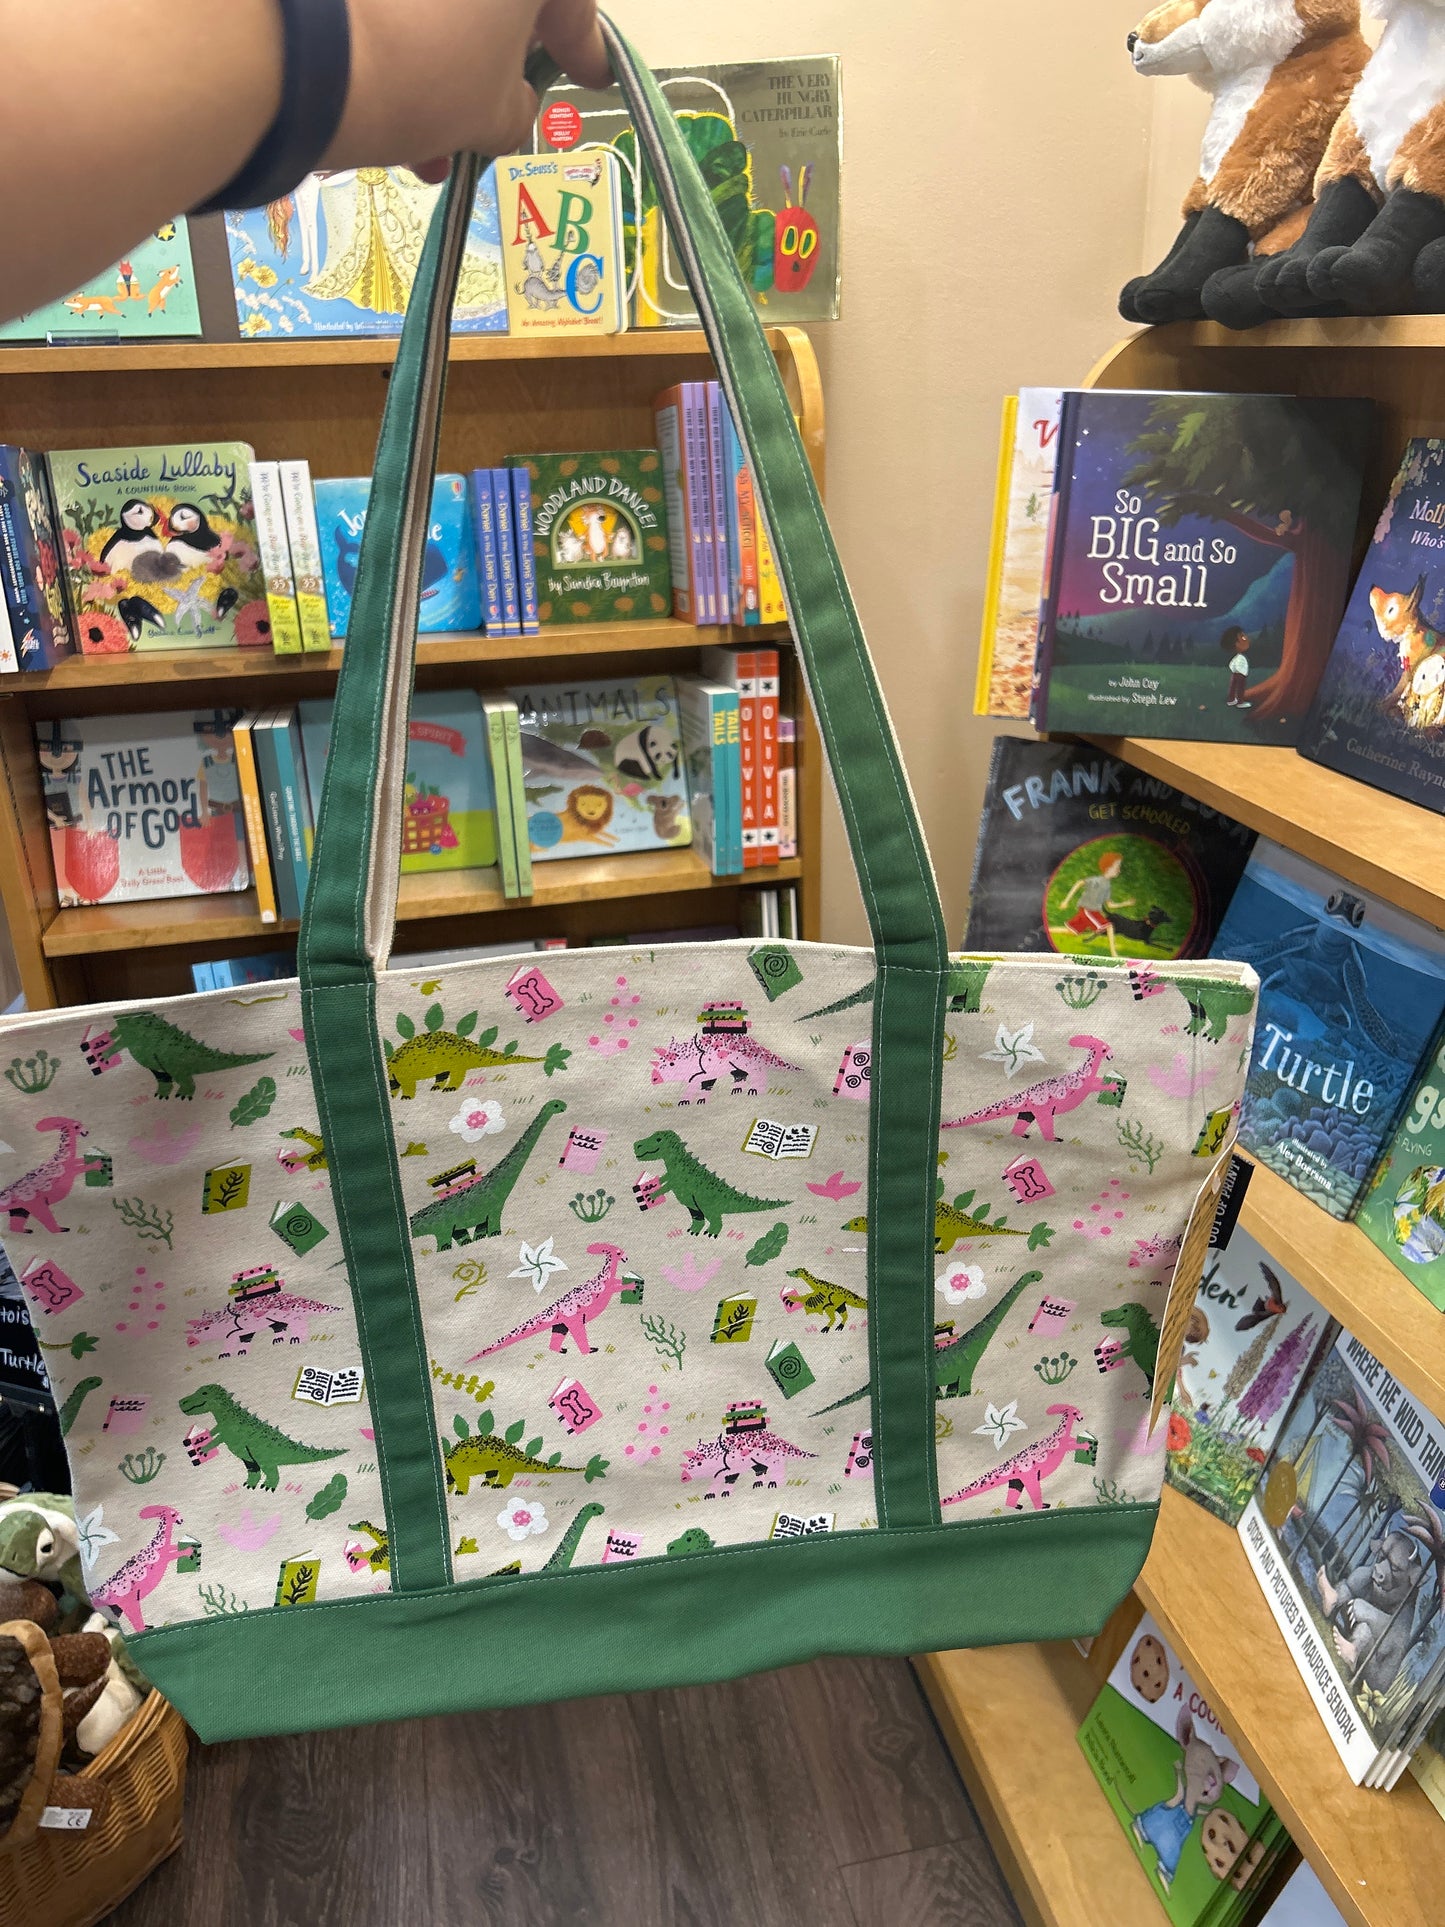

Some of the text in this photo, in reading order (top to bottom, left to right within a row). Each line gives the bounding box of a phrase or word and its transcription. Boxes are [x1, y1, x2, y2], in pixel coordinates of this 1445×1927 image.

[767, 73, 830, 90] THE VERY
[777, 89, 831, 105] HUNGRY
[741, 105, 833, 123] CATERPILLAR
[508, 167, 525, 181] Dr.
[525, 161, 558, 177] Seuss's
[75, 451, 237, 501] Seaside Lullaby
[126, 485, 170, 495] COUNTING
[173, 484, 197, 493] BOOK
[532, 477, 659, 536] WOODLAND DANCE!
[1114, 489, 1142, 514] So
[481, 502, 493, 532] Daniel
[488, 583, 498, 602] Den
[498, 502, 509, 532] Daniel
[505, 583, 515, 601] Den
[519, 502, 530, 531] Daniel
[525, 582, 535, 601] Den
[1087, 515, 1237, 565] BIG and So
[1410, 530, 1445, 549] Who's
[547, 571, 650, 596] by Sandra Boynton
[1099, 561, 1208, 608] Small
[1118, 676, 1141, 688] John
[1131, 692, 1157, 706] Steph
[1159, 693, 1178, 705] Lew
[521, 687, 671, 728] ANIMALS
[713, 710, 726, 745] TAILS
[727, 708, 739, 743] TAILS
[101, 747, 153, 780] THE
[741, 707, 754, 820] OLIVIA
[762, 705, 774, 819] OLIVIA
[1346, 737, 1407, 771] Catherine
[88, 768, 195, 809] Armor
[1002, 759, 1173, 822] FRANK AND
[107, 811, 138, 839] OF
[141, 793, 202, 849] God
[1088, 802, 1118, 821] GET
[1122, 805, 1191, 835] SCHOOLED
[1258, 1022, 1374, 1115] Turtle
[1290, 1137, 1329, 1169] illustrated by
[1401, 1137, 1432, 1157] FLYING
[1276, 1141, 1333, 1190] Alex Boersma
[1209, 1159, 1241, 1244] OUT OF PRINT
[0, 1347, 46, 1376] Turtle
[1346, 1336, 1385, 1389] WHERE
[1375, 1370, 1402, 1414] THE
[1393, 1397, 1425, 1449] WILD
[1246, 1515, 1357, 1745] STORY AND PICTURES BY MAURICE SENDAK
[1173, 1681, 1184, 1701] A
